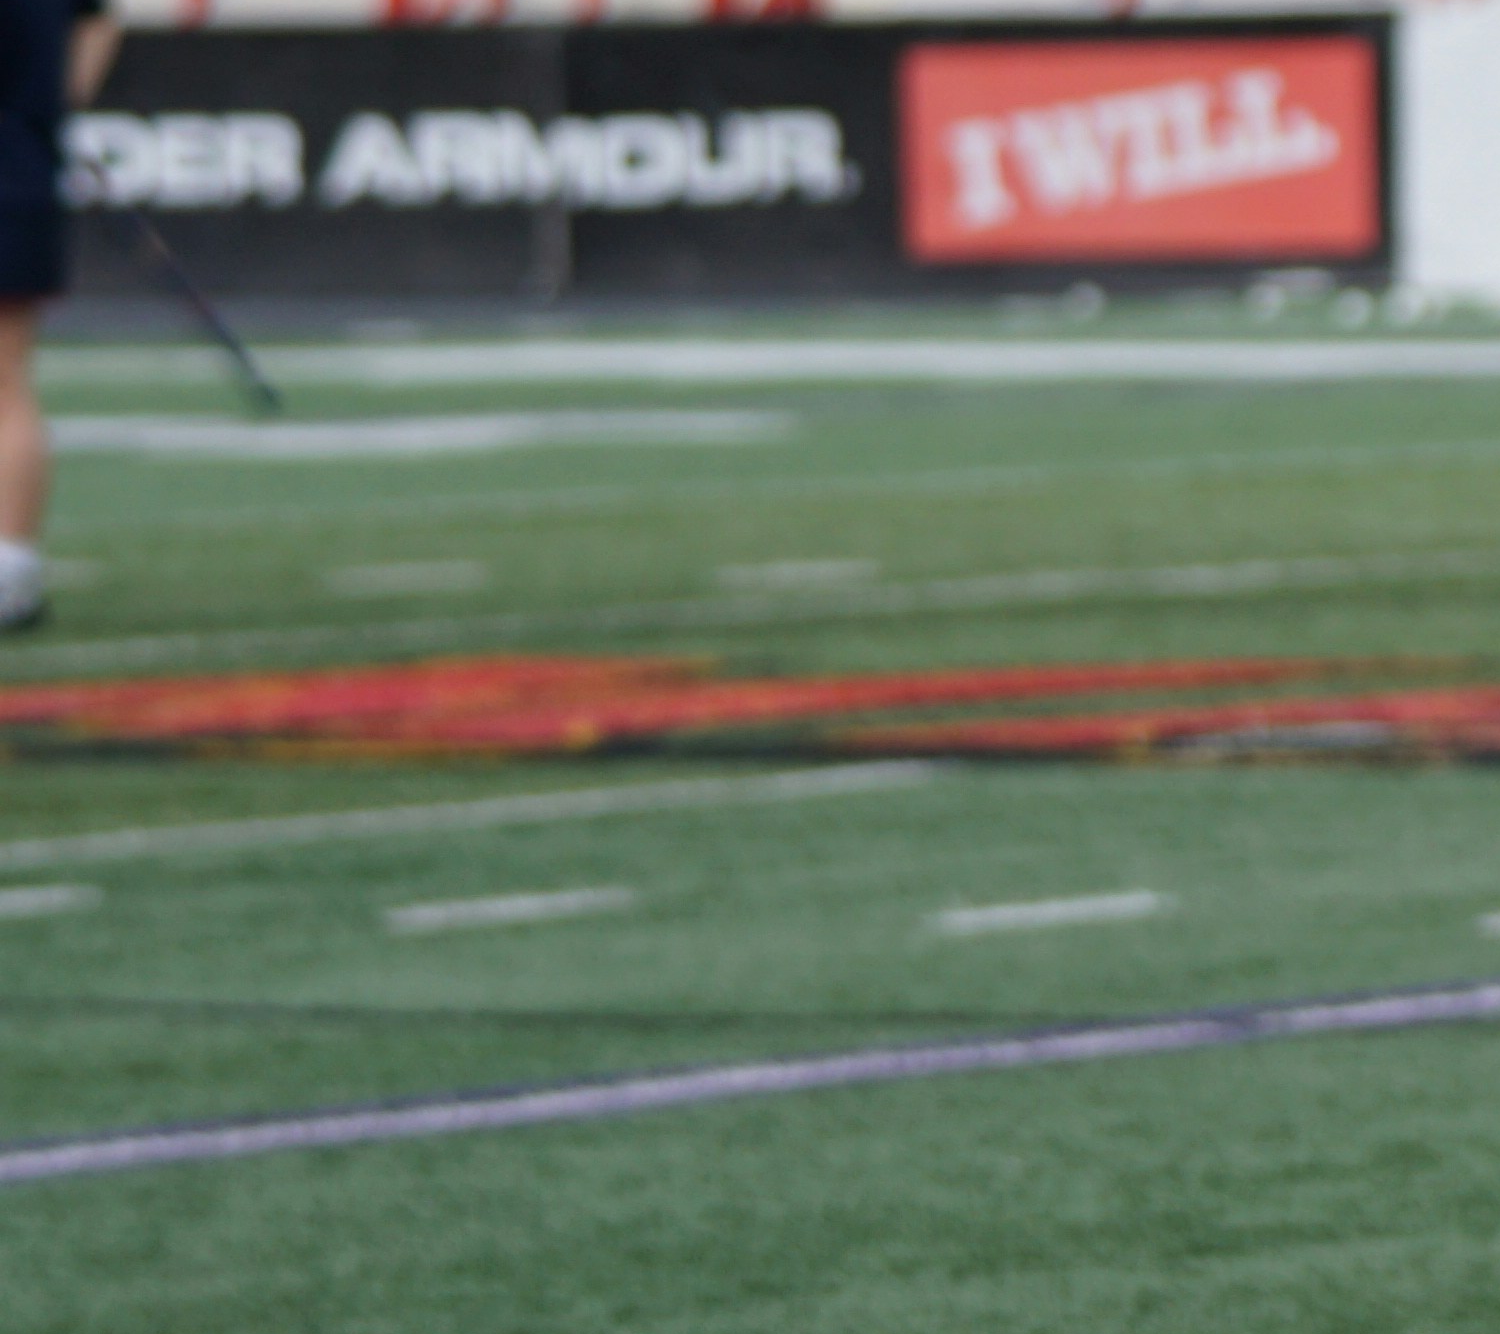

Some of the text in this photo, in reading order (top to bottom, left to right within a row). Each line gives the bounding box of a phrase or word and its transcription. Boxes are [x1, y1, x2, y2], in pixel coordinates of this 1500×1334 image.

[66, 105, 845, 211] DER ARMOUR
[945, 67, 1340, 230] I WILL
